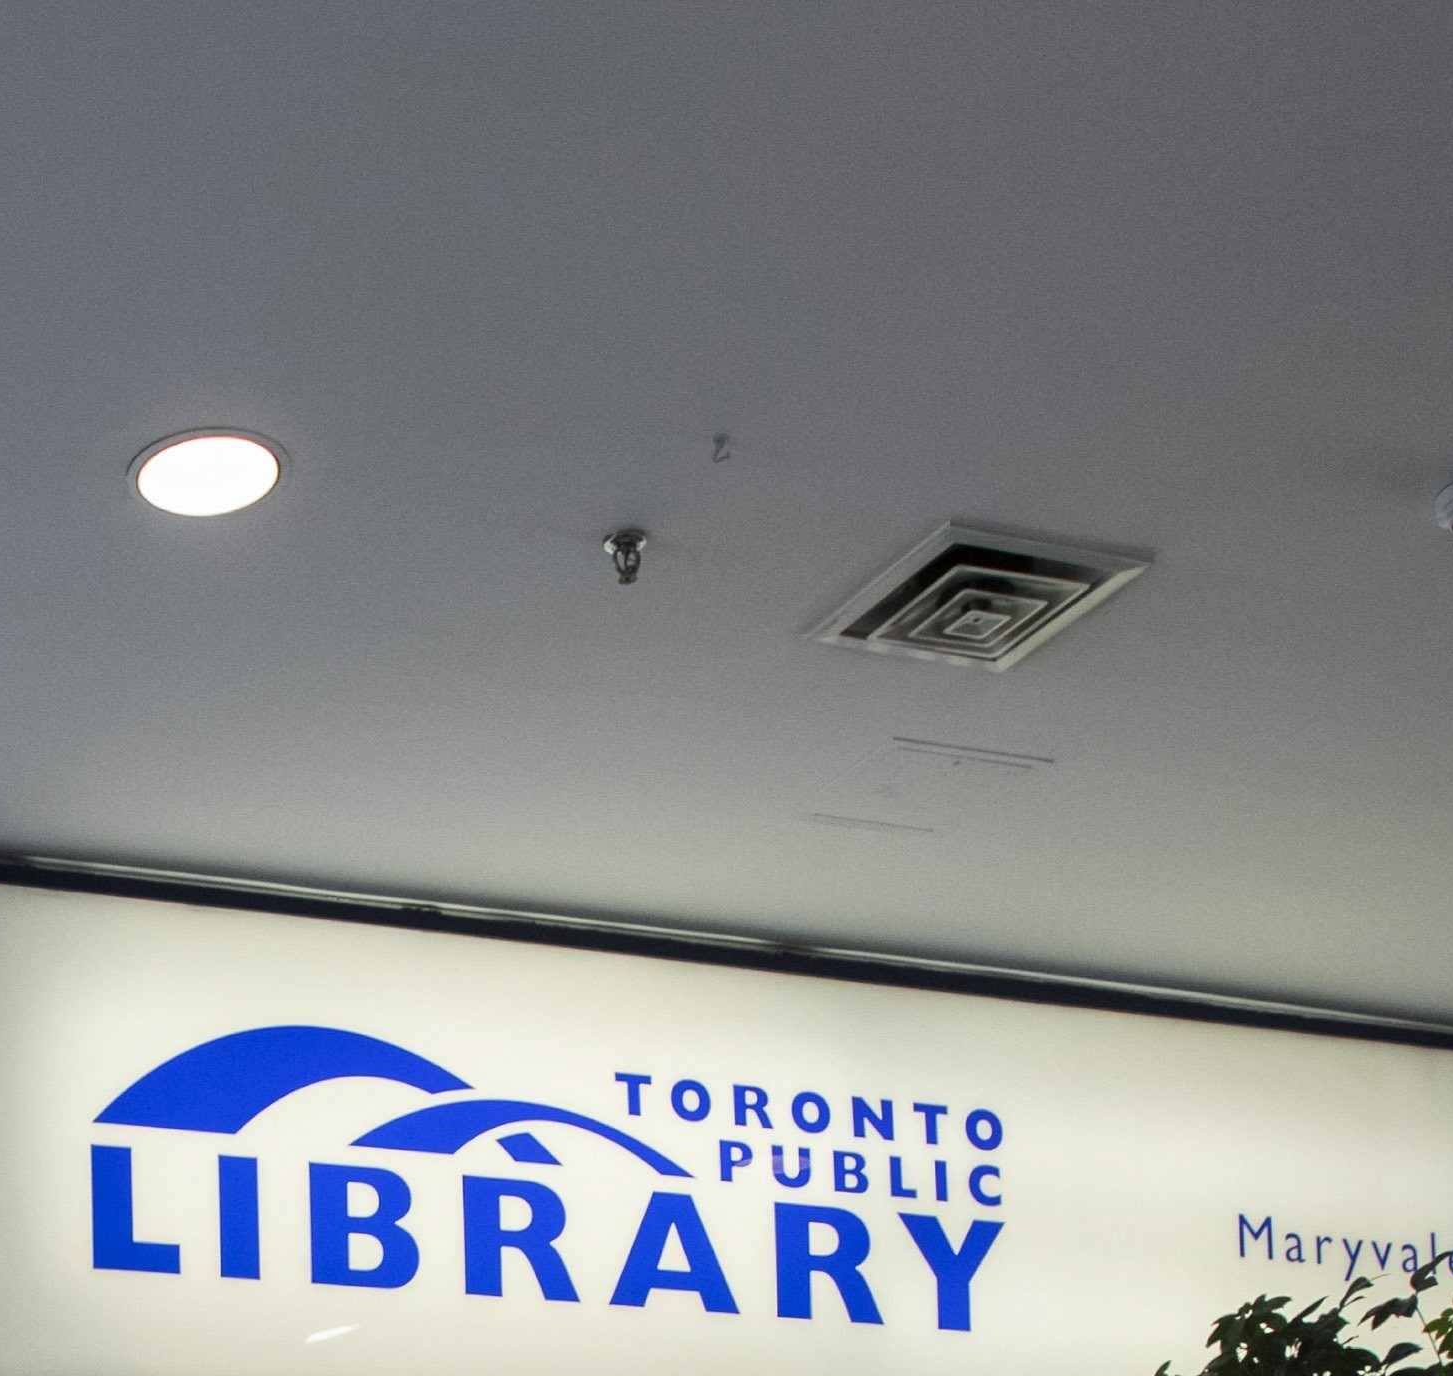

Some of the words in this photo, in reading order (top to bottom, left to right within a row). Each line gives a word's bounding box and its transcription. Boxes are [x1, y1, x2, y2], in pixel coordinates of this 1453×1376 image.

[614, 1072, 1003, 1150] TORONTO
[718, 1139, 1002, 1206] PUBLIC
[90, 1144, 1004, 1332] LIBRARY
